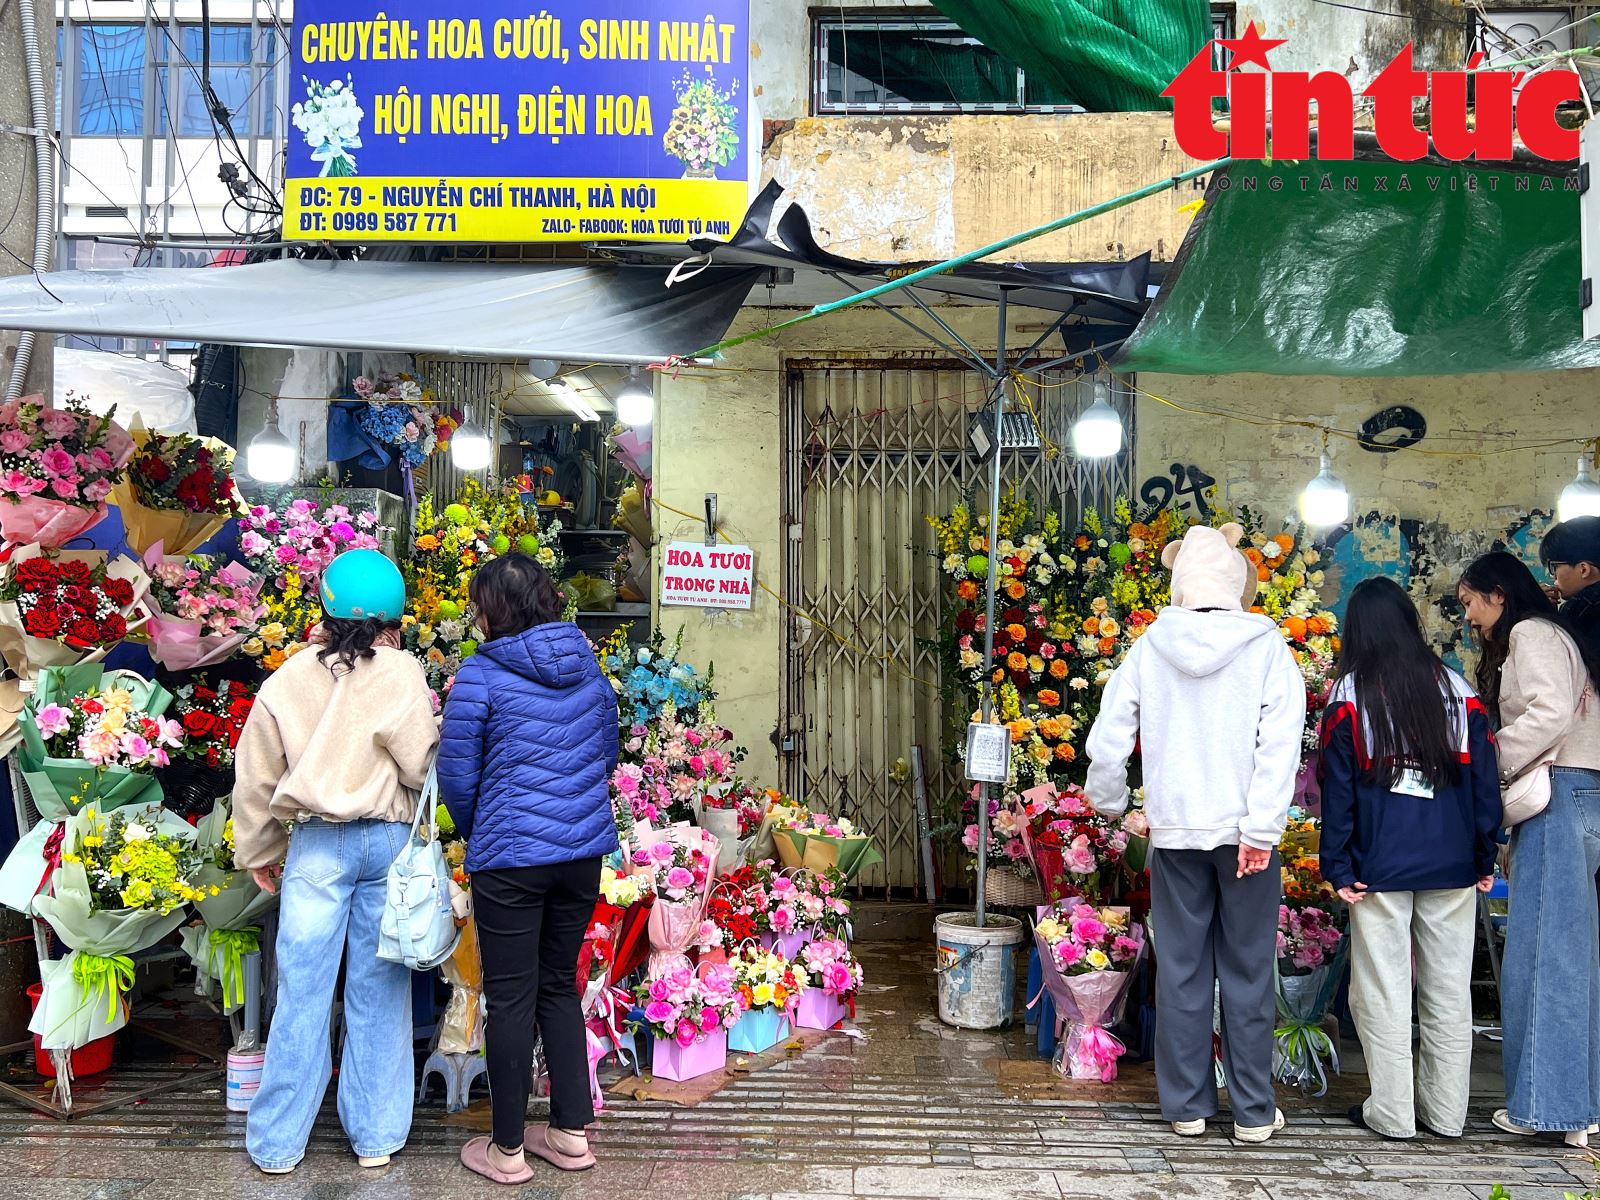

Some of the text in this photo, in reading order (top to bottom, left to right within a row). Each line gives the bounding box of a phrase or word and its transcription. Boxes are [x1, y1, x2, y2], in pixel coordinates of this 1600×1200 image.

[301, 10, 735, 74] CHUYÊN: HOA CƯỚI, SINH NHẬT
[374, 85, 653, 144] HỘI NGHỊ, ĐIỆN HOA
[300, 187, 332, 207] ĐC:
[338, 186, 363, 207] 79
[382, 179, 463, 207] NGUYỄN
[469, 183, 503, 208] CHÍ
[509, 187, 581, 211] THANH,
[587, 183, 616, 208] HÀ
[621, 184, 656, 213] NỘI
[300, 212, 457, 232] ĐT: 0989 587 771
[542, 216, 730, 235] ZALO- FABOOK: HOA TƯƠI TÚ ANH
[667, 550, 752, 570] HOA TƯƠI
[665, 576, 750, 594] TRONG NHÀ
